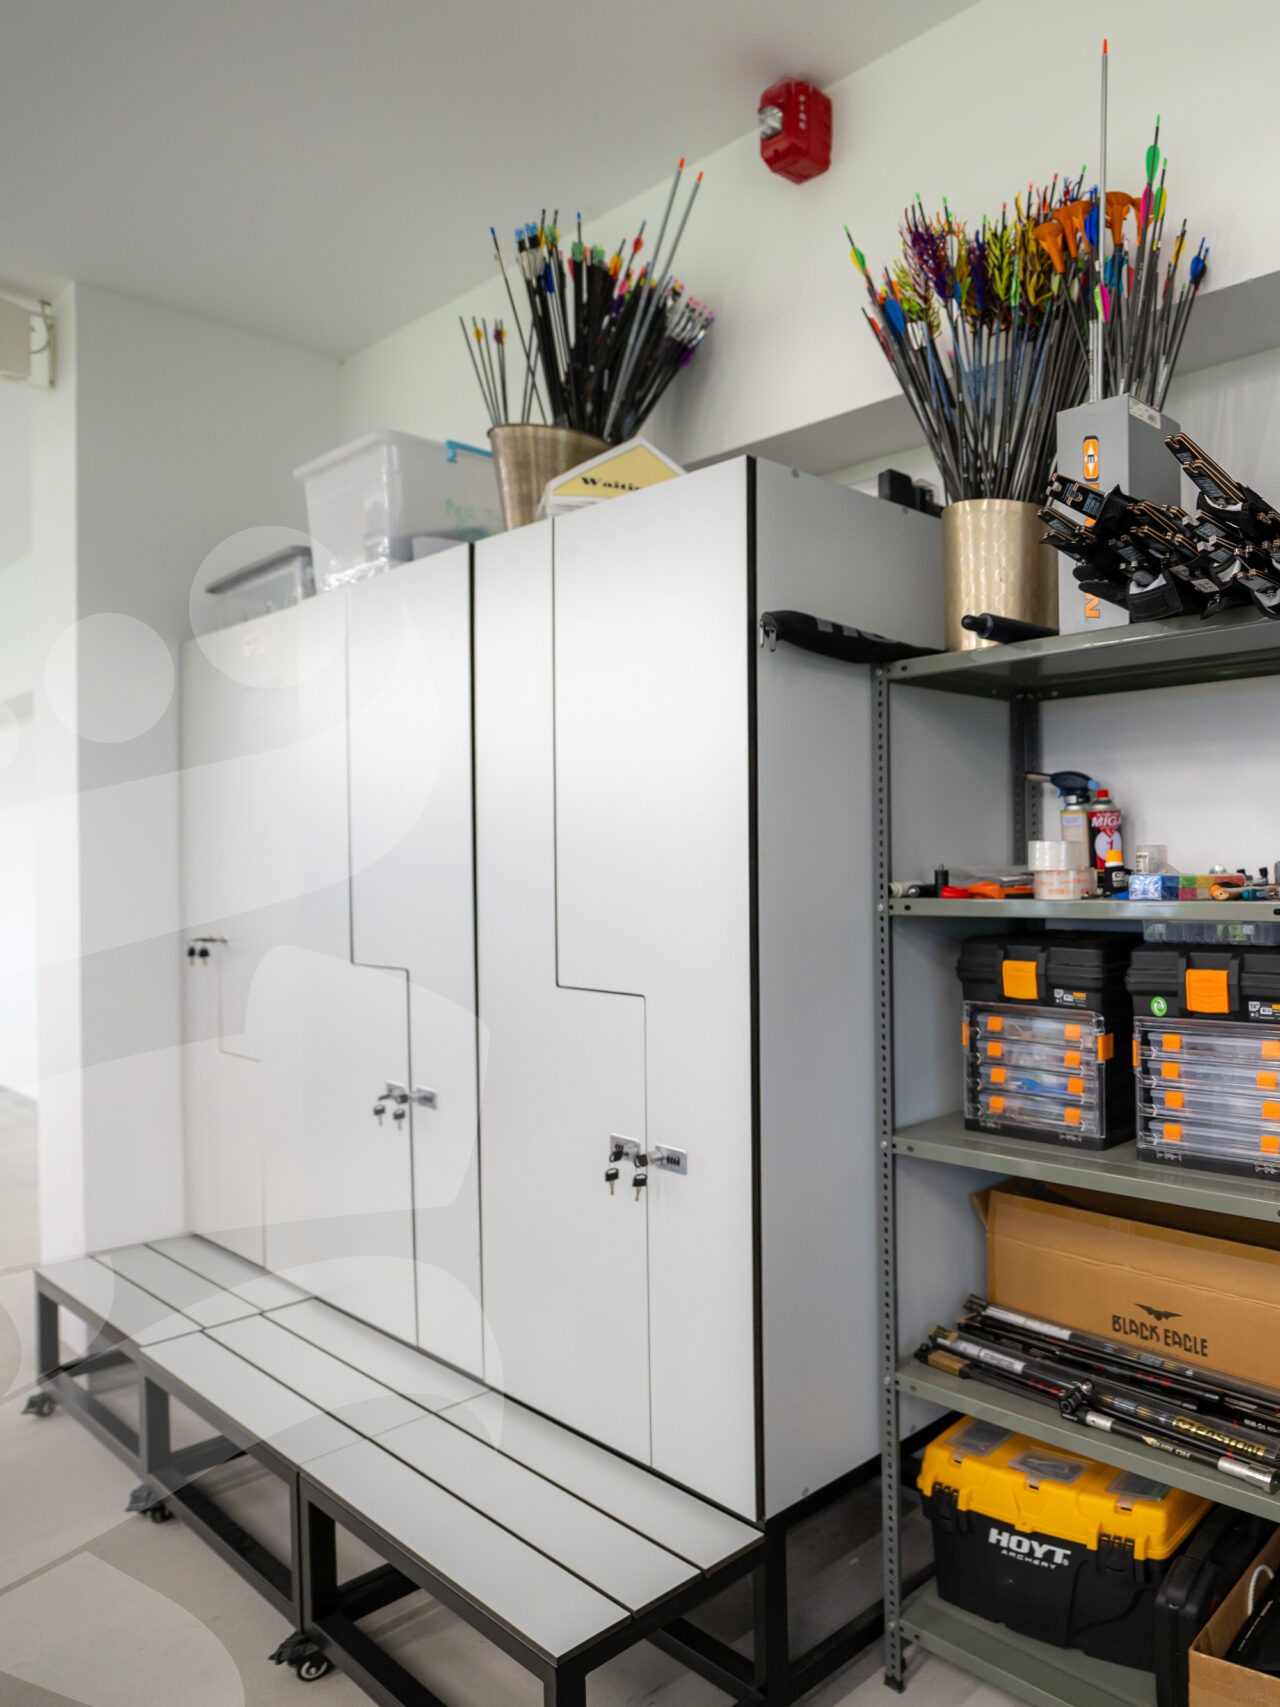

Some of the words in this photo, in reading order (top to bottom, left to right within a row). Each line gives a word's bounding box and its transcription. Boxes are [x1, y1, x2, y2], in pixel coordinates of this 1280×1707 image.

[1112, 1314, 1160, 1342] BLACK
[1163, 1328, 1208, 1357] EAGLE
[988, 1527, 1072, 1564] HOYT
[1001, 1549, 1057, 1570] ARCHERY
